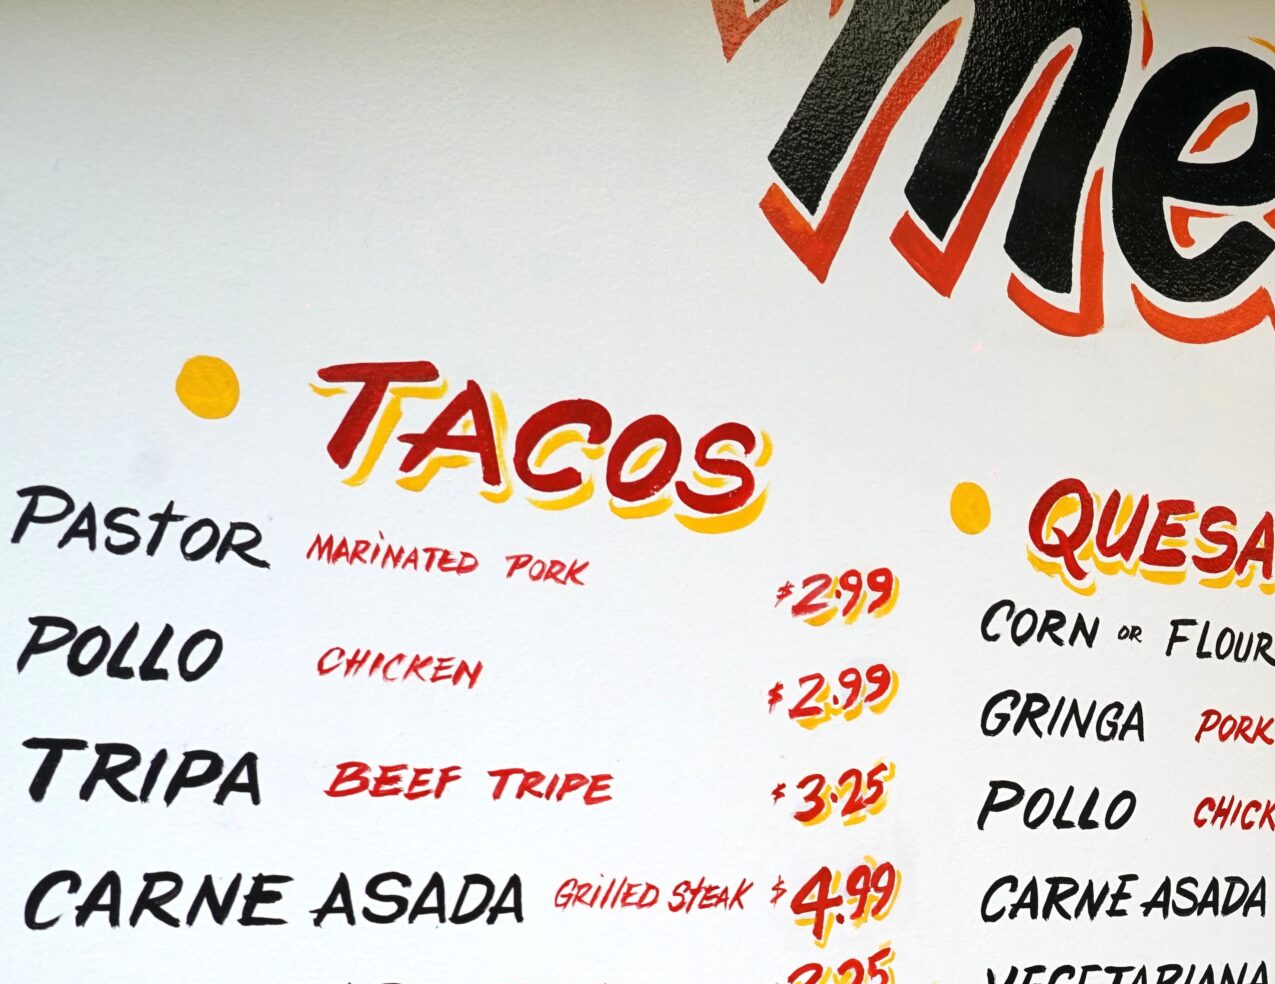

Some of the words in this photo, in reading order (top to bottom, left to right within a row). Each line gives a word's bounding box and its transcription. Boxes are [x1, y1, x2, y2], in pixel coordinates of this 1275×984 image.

[309, 360, 773, 534] TACOS
[507, 554, 588, 585] PORK
[777, 568, 896, 620] $2.99
[981, 600, 1099, 648] CORN
[17, 616, 223, 682] POLLO
[318, 647, 482, 688] CHICKEN
[768, 664, 894, 723] $2.99
[981, 690, 1144, 742] GRINGA
[1195, 709, 1274, 745] PORK
[22, 737, 260, 807] TRIPA
[324, 761, 460, 800] BEEF
[488, 768, 612, 805] TRIPE
[772, 764, 890, 826] $3.25
[977, 780, 1136, 830] POLLO
[25, 870, 294, 930] CARNE
[309, 872, 523, 927] ASADA
[771, 862, 898, 944] $4.99
[981, 874, 1139, 922] CARNE
[1141, 876, 1266, 920] ASADA
